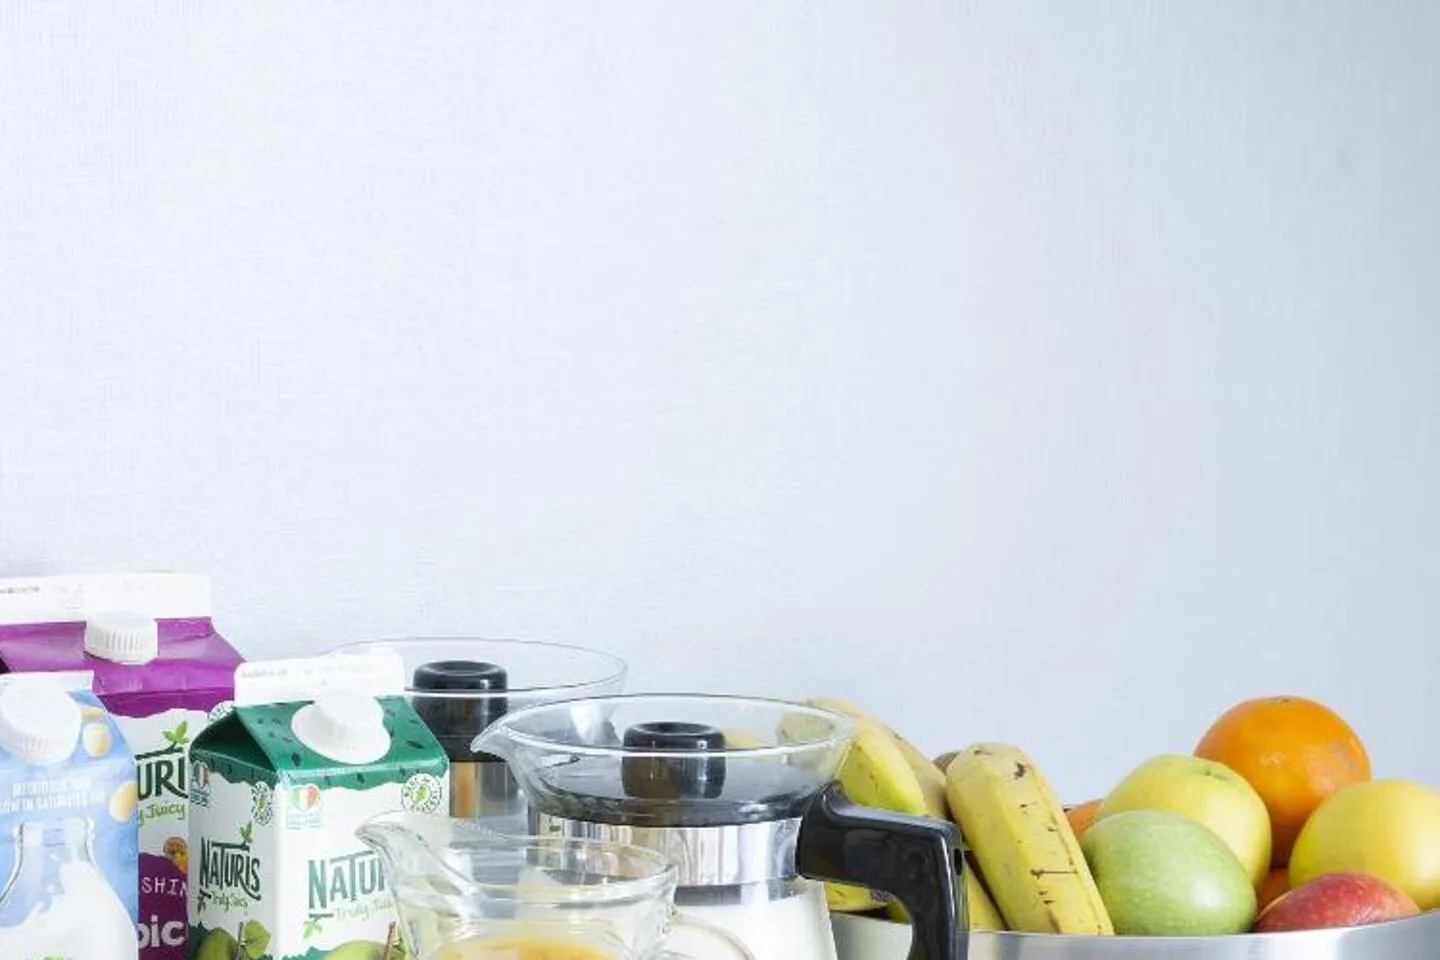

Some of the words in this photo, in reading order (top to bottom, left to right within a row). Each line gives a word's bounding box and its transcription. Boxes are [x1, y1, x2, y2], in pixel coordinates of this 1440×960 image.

[135, 748, 188, 800] URI
[150, 801, 185, 820] Juicy
[141, 877, 188, 897] SHIN
[199, 836, 262, 900] NATURIS
[308, 849, 385, 910] NATU
[139, 915, 188, 949] ic
